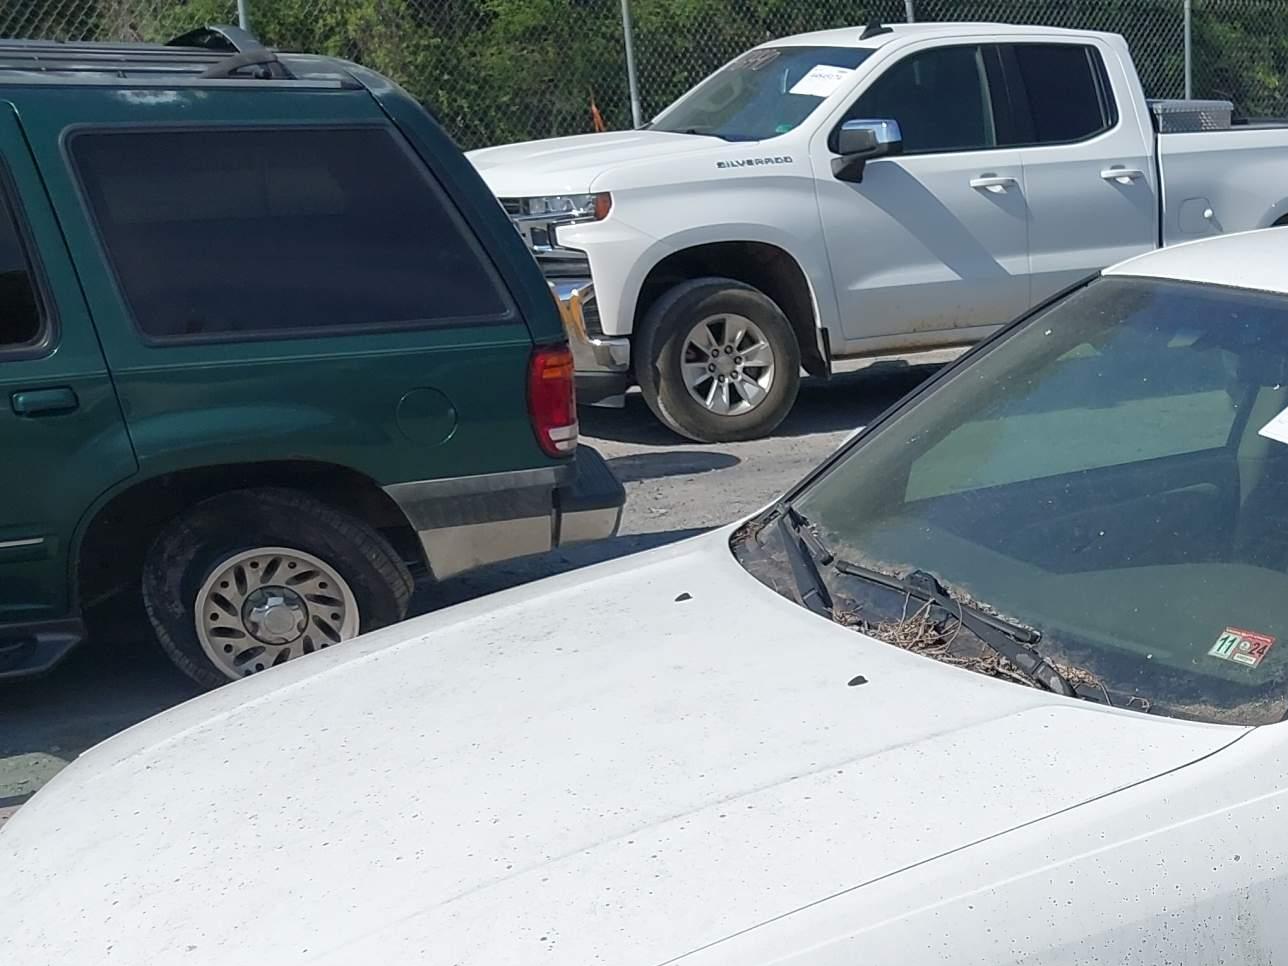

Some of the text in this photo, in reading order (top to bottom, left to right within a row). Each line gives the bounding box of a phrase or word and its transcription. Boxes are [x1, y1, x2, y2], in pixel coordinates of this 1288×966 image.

[716, 156, 793, 169] SILVERADO
[1216, 634, 1238, 654] 11
[1248, 642, 1268, 656] 24
